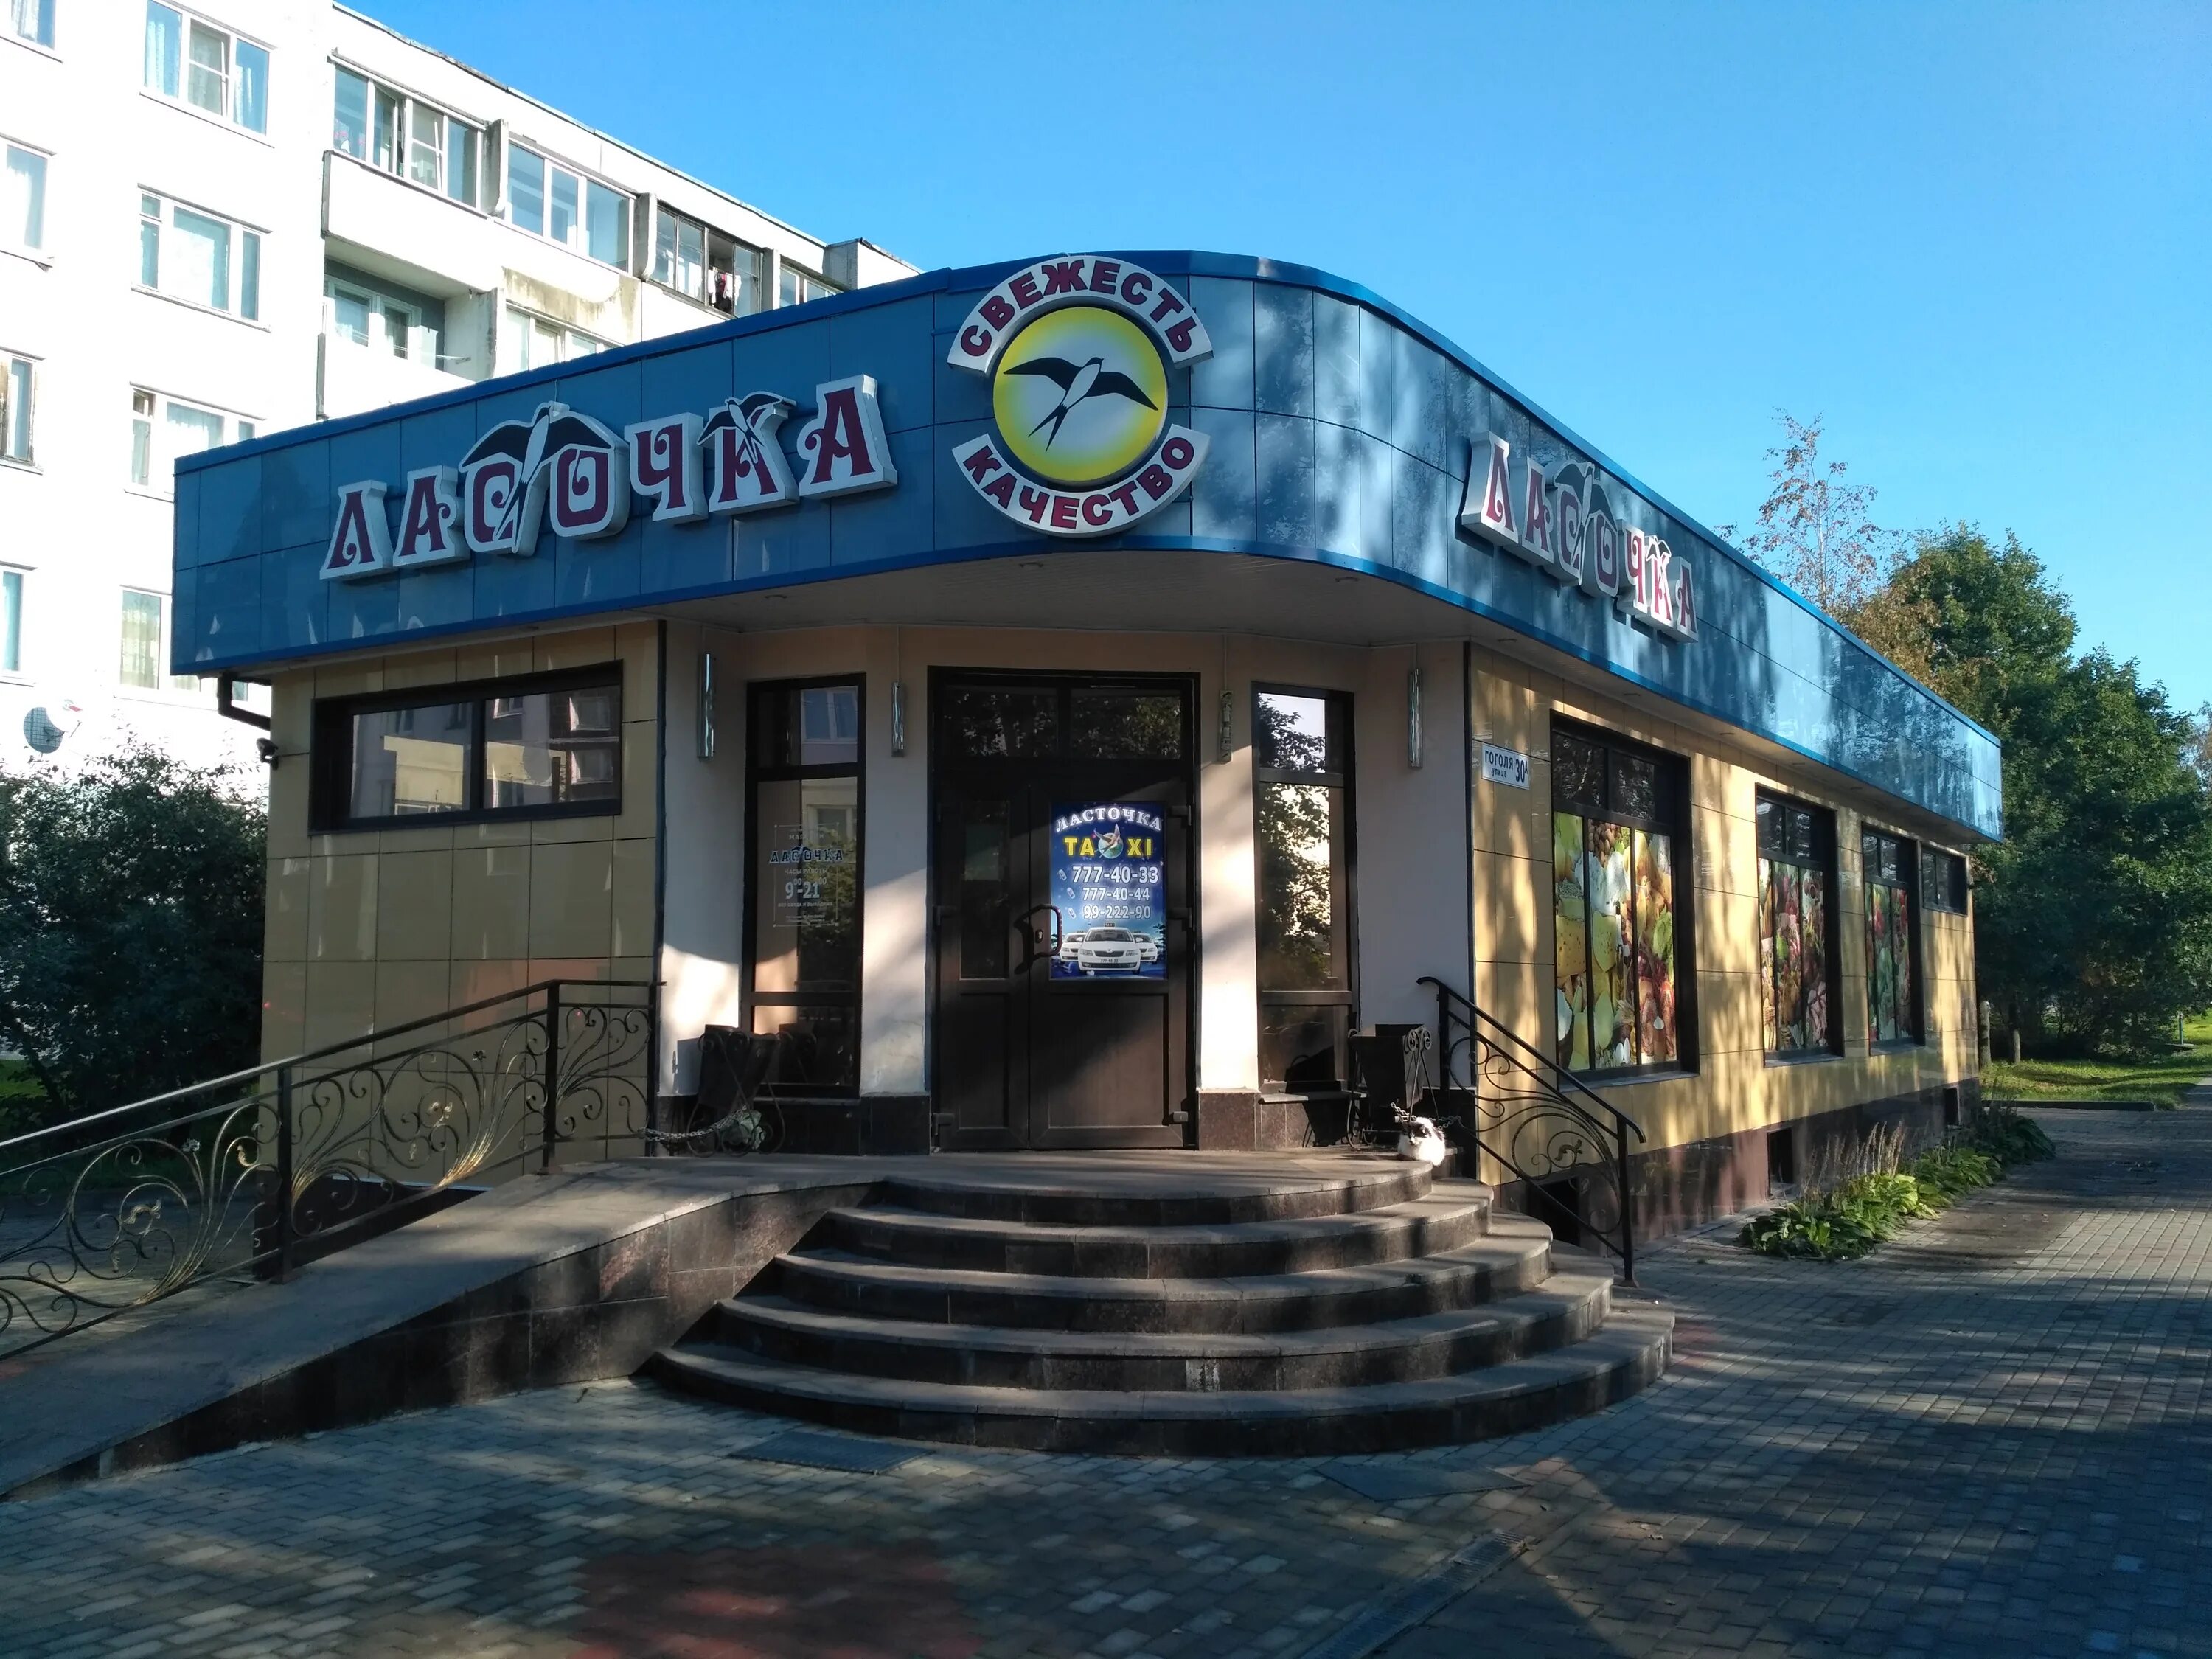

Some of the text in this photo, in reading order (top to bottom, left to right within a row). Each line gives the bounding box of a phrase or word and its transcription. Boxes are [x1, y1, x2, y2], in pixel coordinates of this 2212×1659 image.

[960, 258, 1197, 358] СВЕЖЕСТЬ
[962, 437, 1195, 529] КАЧЕСТВО
[1485, 750, 1513, 770] ГОГОЛЯ
[1056, 807, 1161, 832] ЛАСТОЧКА
[1072, 866, 1159, 883] 777-40-33
[1082, 887, 1150, 901] 777-40-44
[1082, 905, 1152, 919] 99-222-90
